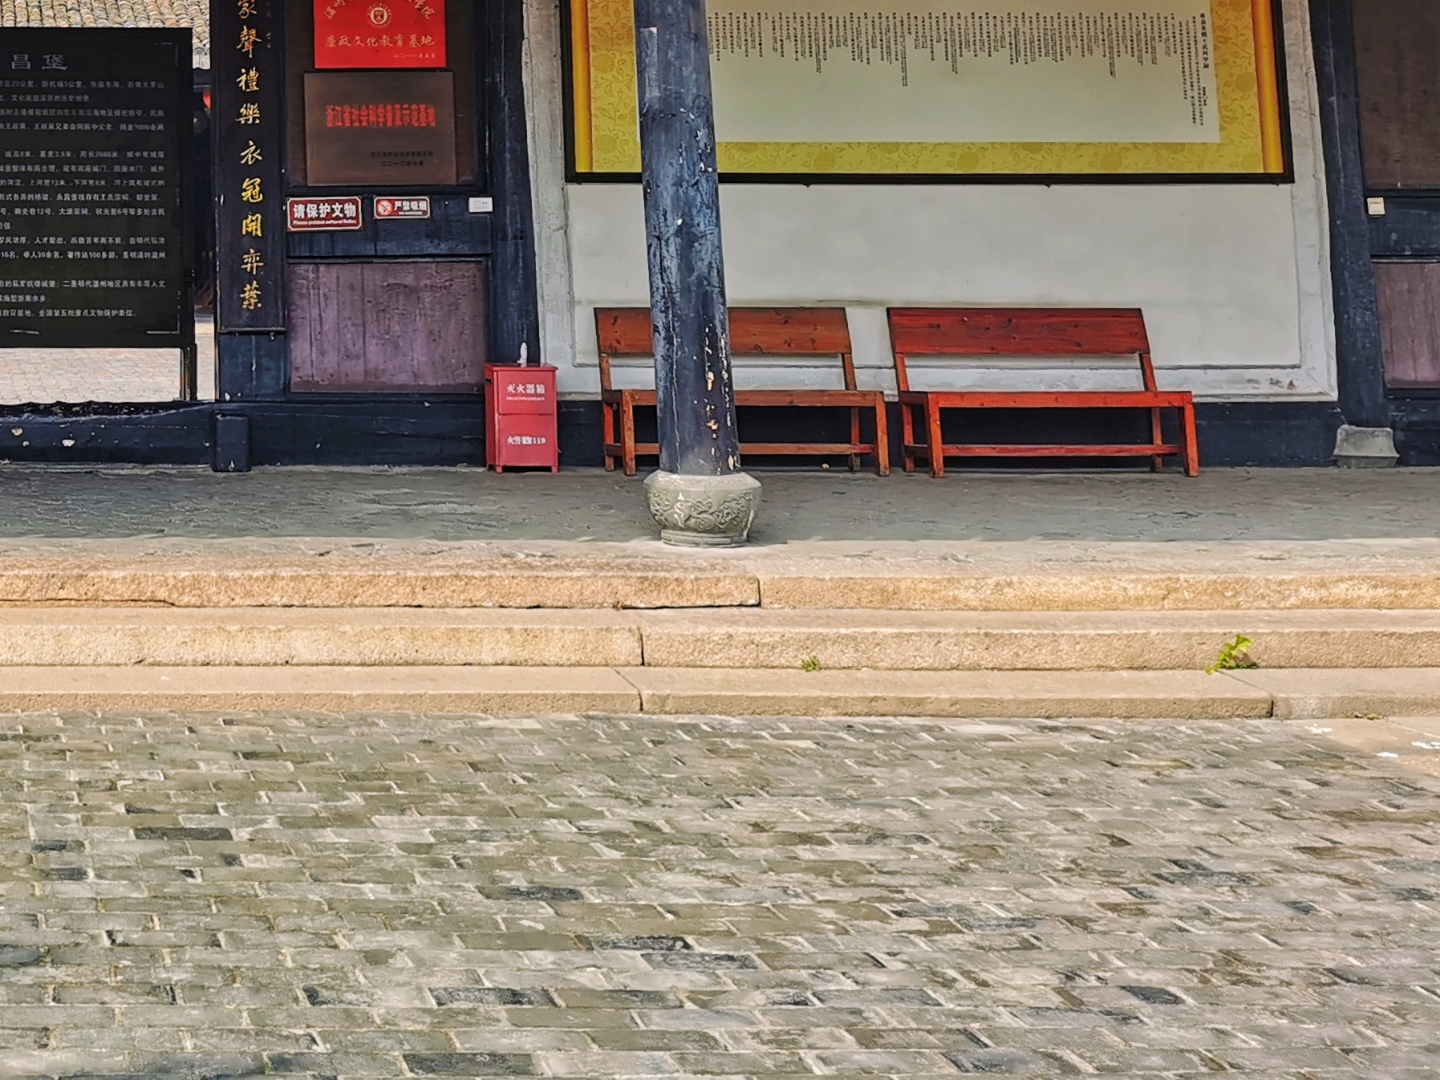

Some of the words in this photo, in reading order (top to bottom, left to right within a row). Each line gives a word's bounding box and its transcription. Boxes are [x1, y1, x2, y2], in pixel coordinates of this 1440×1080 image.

[324, 34, 436, 48] 廉政文化教育基地
[293, 202, 357, 219] 请保护文物
[393, 200, 428, 212] 严禁吸烟
[506, 383, 546, 395] 灭火器箱
